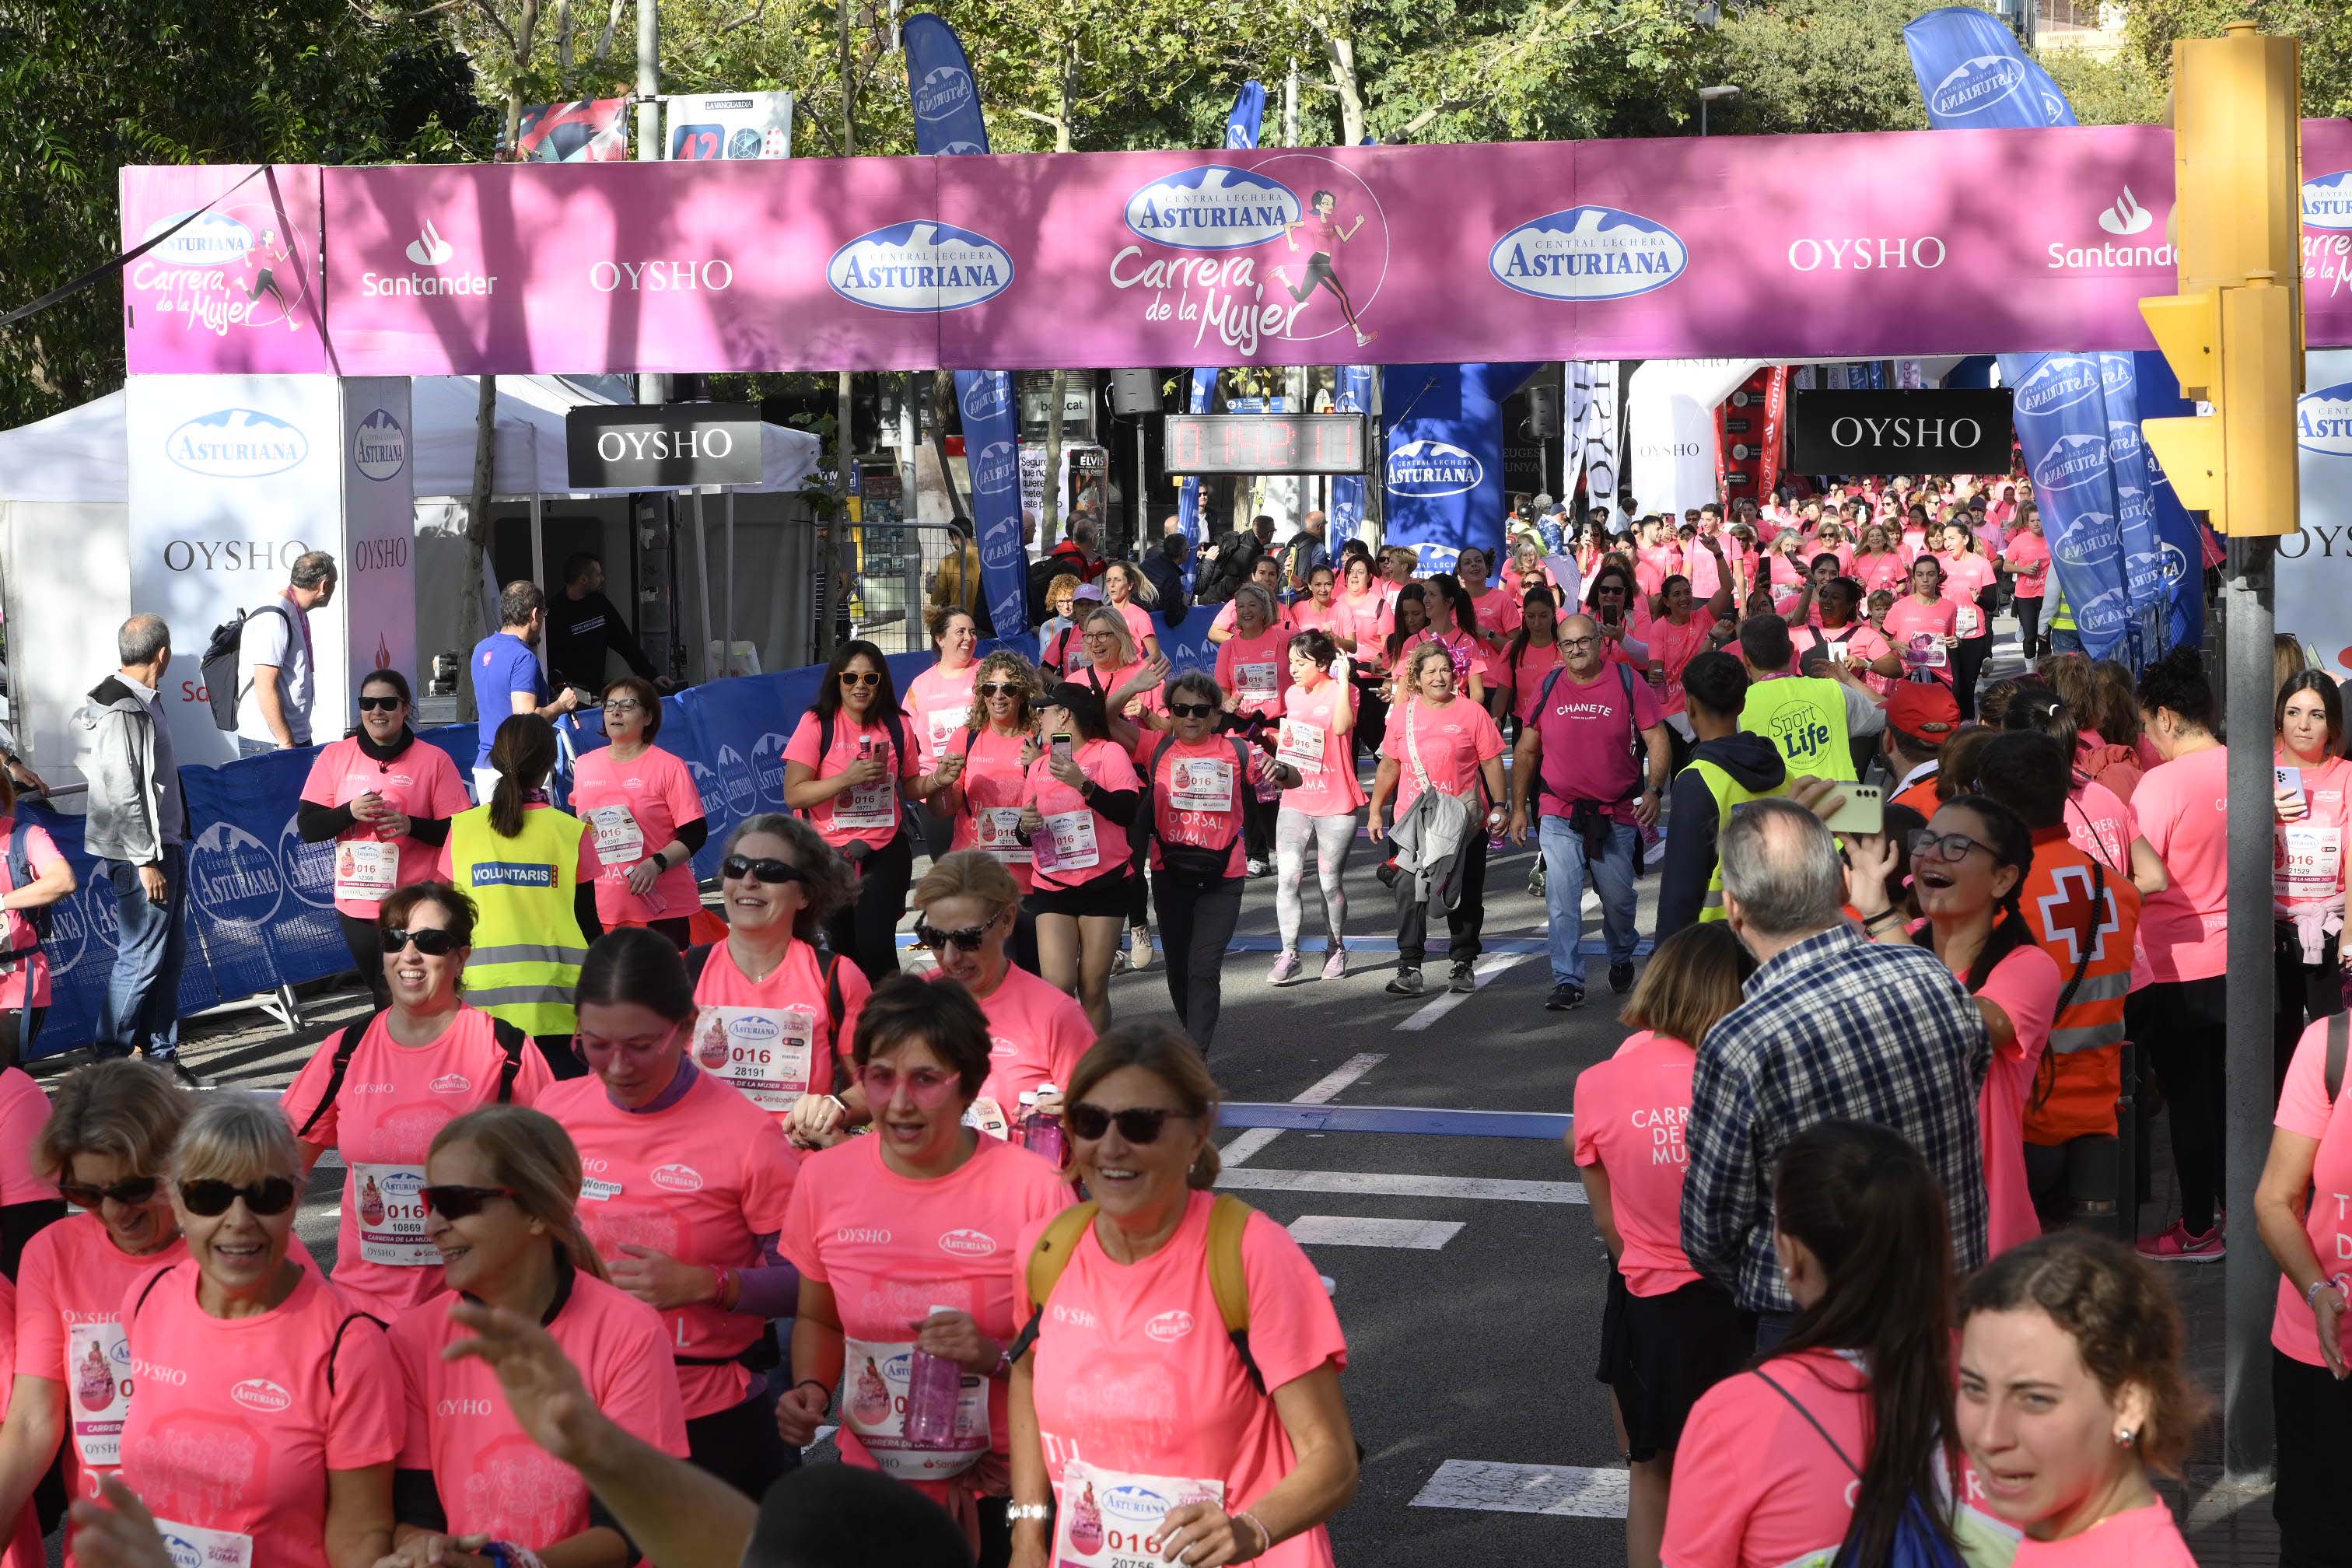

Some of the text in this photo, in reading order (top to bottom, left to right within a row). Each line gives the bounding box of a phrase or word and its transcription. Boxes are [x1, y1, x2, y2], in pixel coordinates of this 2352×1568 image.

[1165, 193, 1283, 202] CENTRAL LECHERA
[1138, 198, 1287, 228] ASTURIANA
[1535, 237, 1666, 249] CENTRAL LECHERA
[1504, 243, 1672, 278] ASTURIANA
[1788, 236, 1946, 271] OYSHO
[842, 254, 999, 289] ASTURIANA
[1109, 245, 1255, 289] Carrera
[2320, 256, 2334, 279] la
[133, 261, 225, 291] Carrera
[362, 272, 497, 296] Santander
[590, 260, 733, 292] OYSHO
[156, 288, 261, 336] de la Mujer
[1146, 282, 1310, 356] de la Mujer
[1831, 417, 1982, 449] OYSHO
[178, 435, 299, 461] ASTURIANA
[357, 435, 404, 464] ASTURIANA
[597, 429, 733, 463] OYSHO
[1640, 443, 1699, 457] OYSHO
[1080, 456, 1104, 466] ELVIS
[1022, 469, 1034, 478] que
[1388, 463, 1475, 485] ASTURIANA
[1022, 479, 1047, 488] quiere
[1023, 499, 1038, 509] este
[163, 540, 310, 572] OYSHO
[355, 537, 407, 572] OYSHO
[1556, 702, 1612, 717] CHANETE
[1771, 704, 1817, 737] Sport
[1295, 739, 1310, 748] 016
[1783, 722, 1830, 758] Life
[1191, 777, 1212, 786] 016
[1408, 778, 1454, 792] DOSAL
[855, 795, 875, 803] 016
[1169, 811, 1224, 830] DORSAL
[2076, 817, 2121, 838] CARRERA
[601, 828, 621, 838] 016
[1056, 835, 1075, 845] 016
[1168, 828, 1208, 847] SUMA
[2103, 834, 2116, 845] LA
[357, 864, 376, 873] 016
[2287, 855, 2314, 866] 016
[287, 858, 335, 887] ASTUR
[473, 868, 549, 881] VOLUNTARIS
[198, 866, 280, 907] ASTURIANA
[734, 1024, 775, 1036] ASTURIANA
[732, 1047, 772, 1063] 016
[734, 1066, 765, 1077] 28191
[354, 1082, 394, 1095] OYSHO
[432, 1081, 467, 1090] ASTURIANA
[1631, 1106, 1689, 1128] CARR
[1653, 1125, 1681, 1146] DE
[583, 1178, 621, 1193] Women
[656, 1172, 698, 1188] ASTURIANA
[387, 1205, 425, 1220] 016
[392, 1223, 422, 1233] 10869
[837, 1228, 892, 1244] OYSHO
[367, 1247, 396, 1257] OYSHO
[943, 1237, 992, 1251] ASTURIANA
[131, 1358, 187, 1387] OYSHO
[236, 1385, 285, 1406] ASTURIANA
[85, 1444, 119, 1454] OYSH
[862, 1438, 912, 1448] CARRERA DE
[1107, 1495, 1166, 1514] ASTURIANA
[1108, 1529, 1163, 1554] 016
[208, 1550, 240, 1563] SUMA
[1111, 1557, 1155, 1568] 20756
